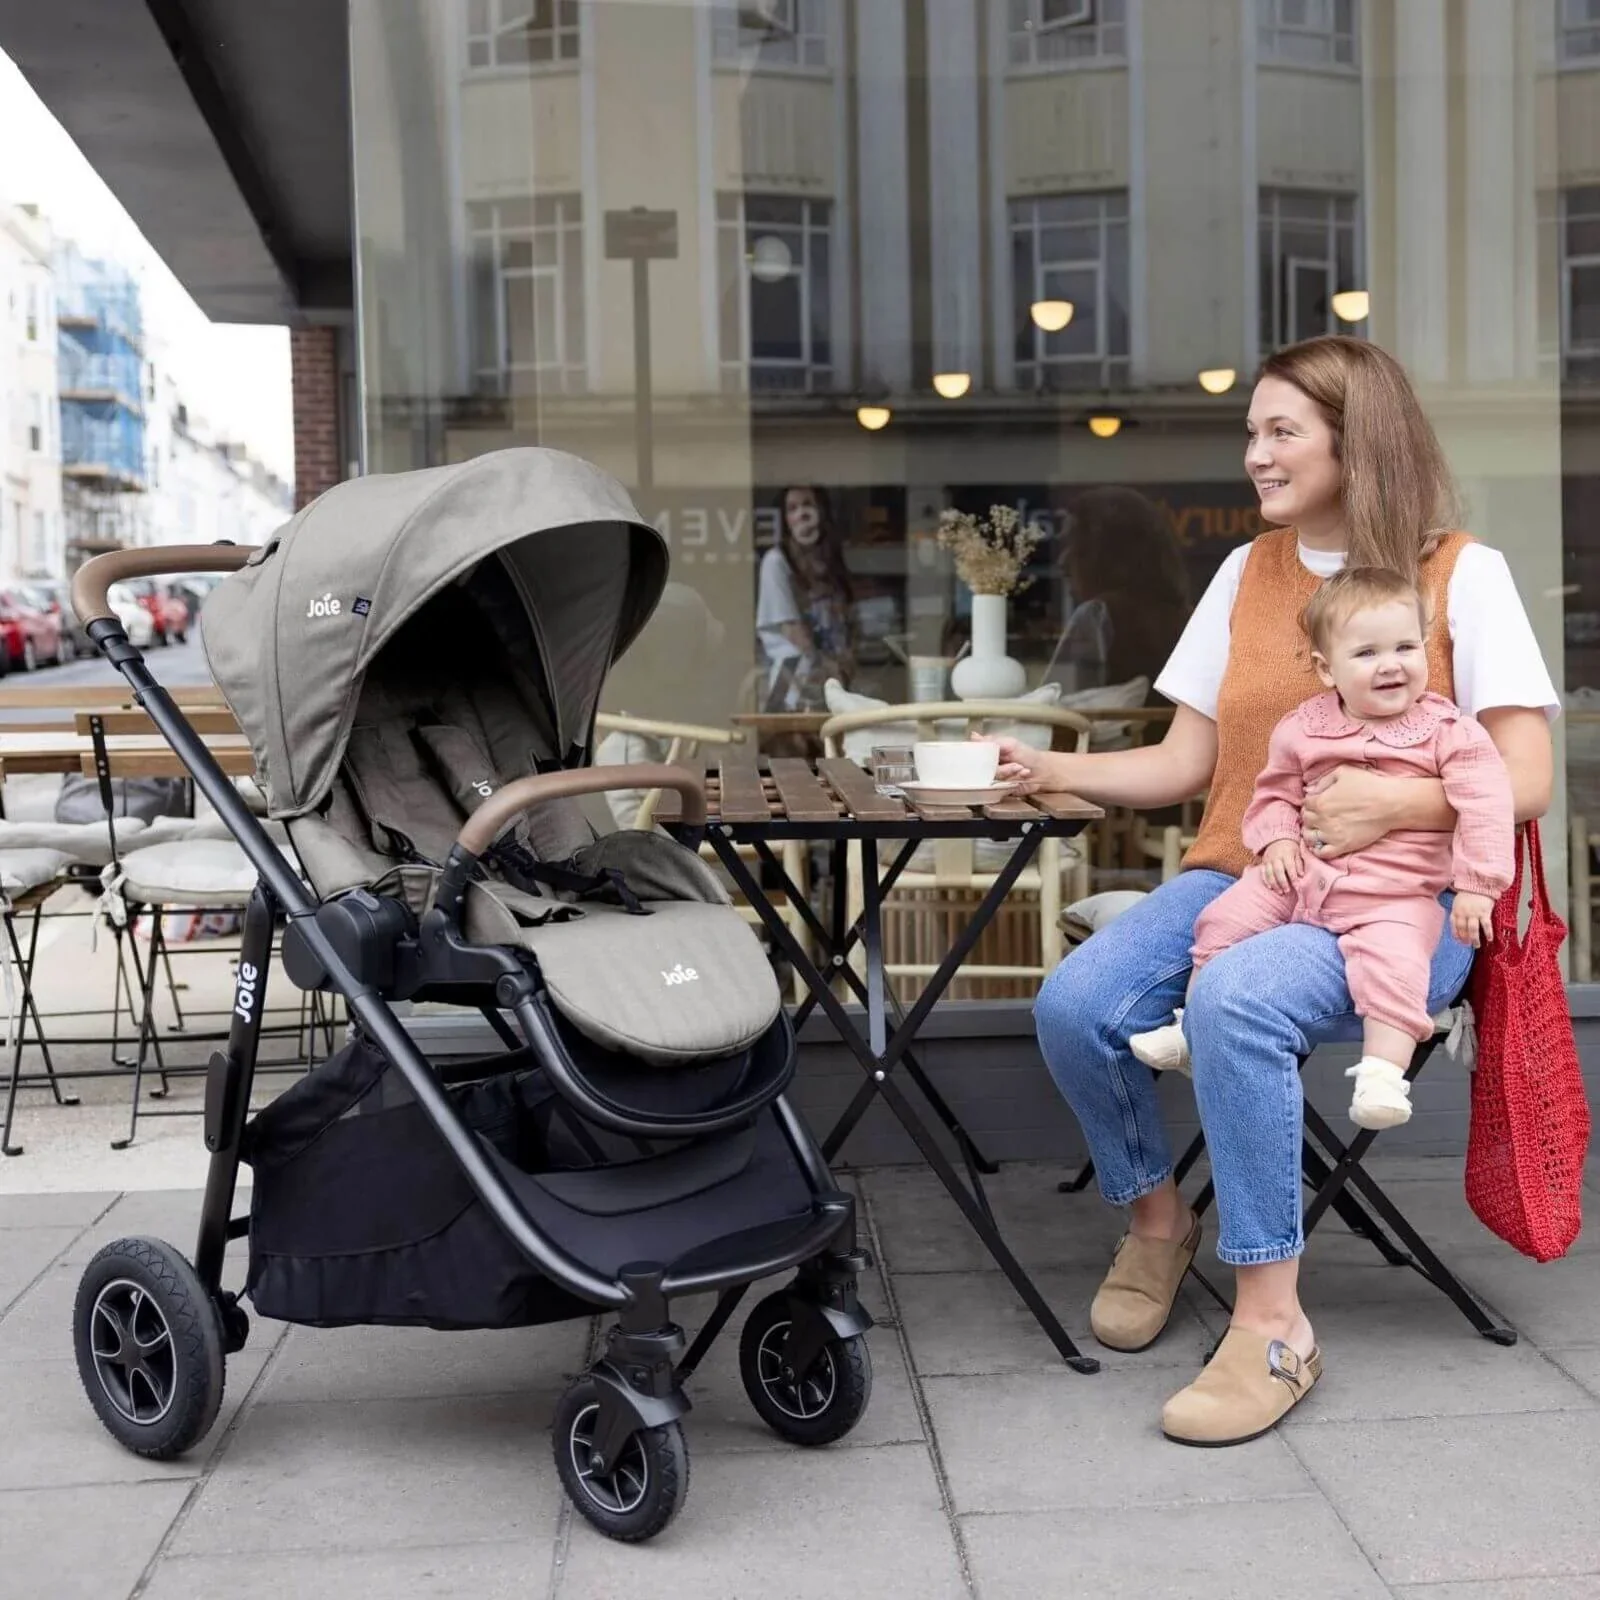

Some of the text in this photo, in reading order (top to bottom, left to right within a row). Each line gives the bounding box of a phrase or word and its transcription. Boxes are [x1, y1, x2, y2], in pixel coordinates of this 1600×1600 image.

[306, 592, 341, 618] Joie
[472, 780, 493, 799] Jo
[660, 963, 699, 986] Joie
[235, 962, 258, 1024] Joie
